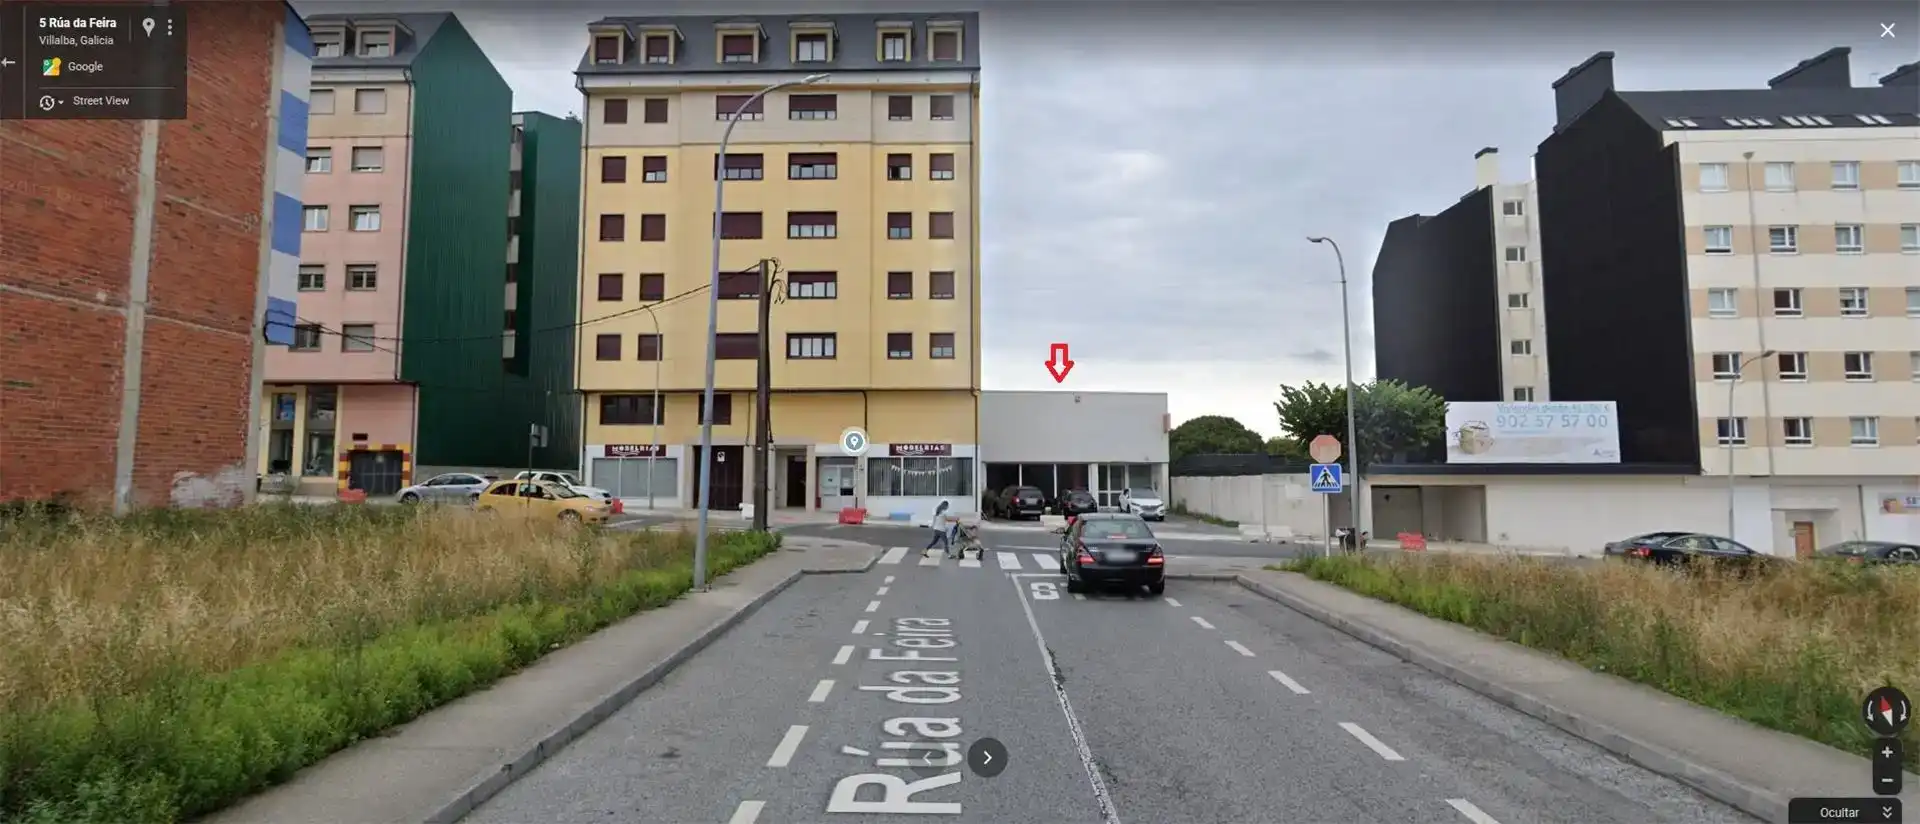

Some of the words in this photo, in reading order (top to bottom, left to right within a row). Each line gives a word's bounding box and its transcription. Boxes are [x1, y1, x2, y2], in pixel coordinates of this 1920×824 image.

[1496, 414, 1528, 428] 902
[1534, 414, 1554, 428] 57
[1561, 414, 1580, 428] 57
[1586, 414, 1608, 428] 00
[867, 617, 958, 661] Feira
[857, 670, 963, 704] da
[826, 716, 963, 814] Rúa
